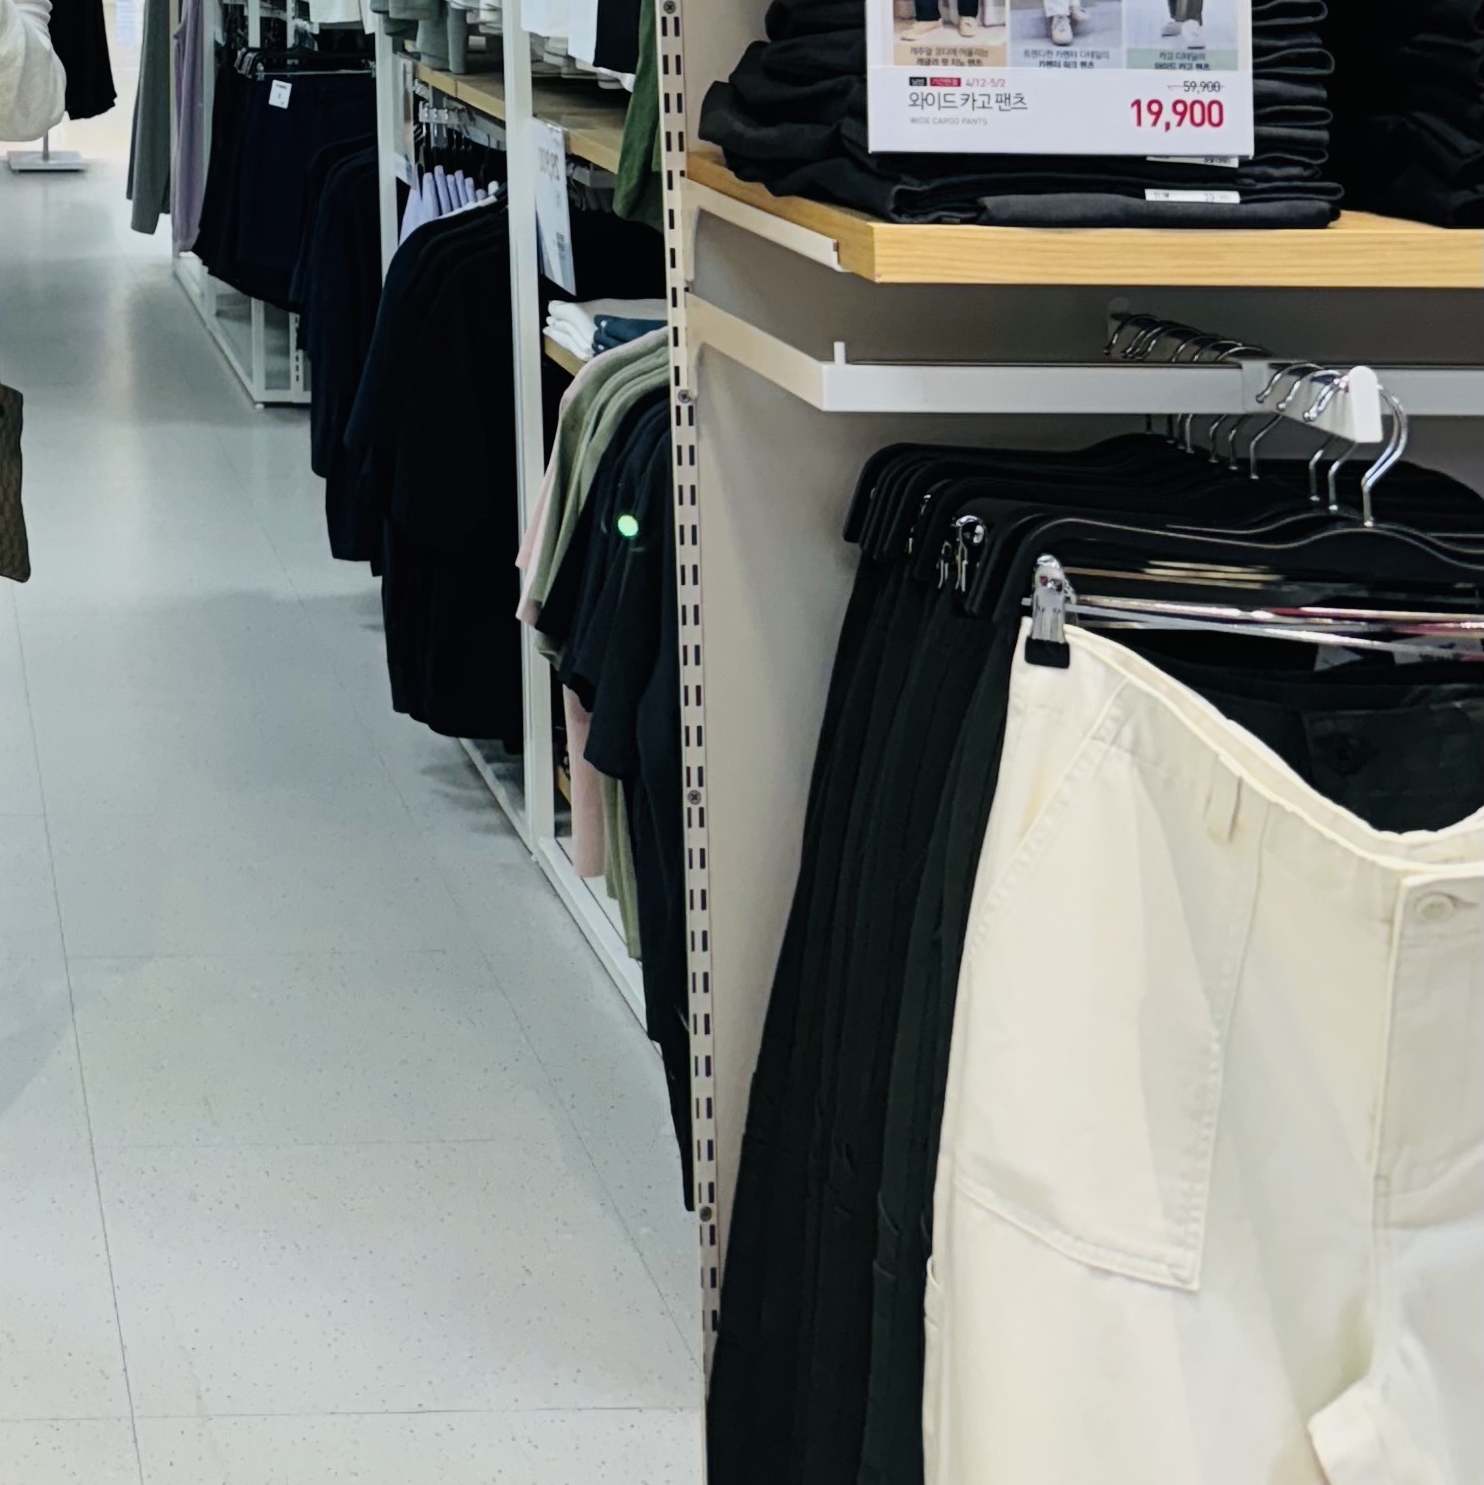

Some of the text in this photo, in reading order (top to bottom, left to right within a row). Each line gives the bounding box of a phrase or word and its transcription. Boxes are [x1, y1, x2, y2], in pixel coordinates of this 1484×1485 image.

[1182, 80, 1221, 94] 59,900
[908, 91, 1028, 112] 와이드 카고 팬츠
[962, 117, 988, 125] PANTS
[1131, 98, 1224, 133] 19,900
